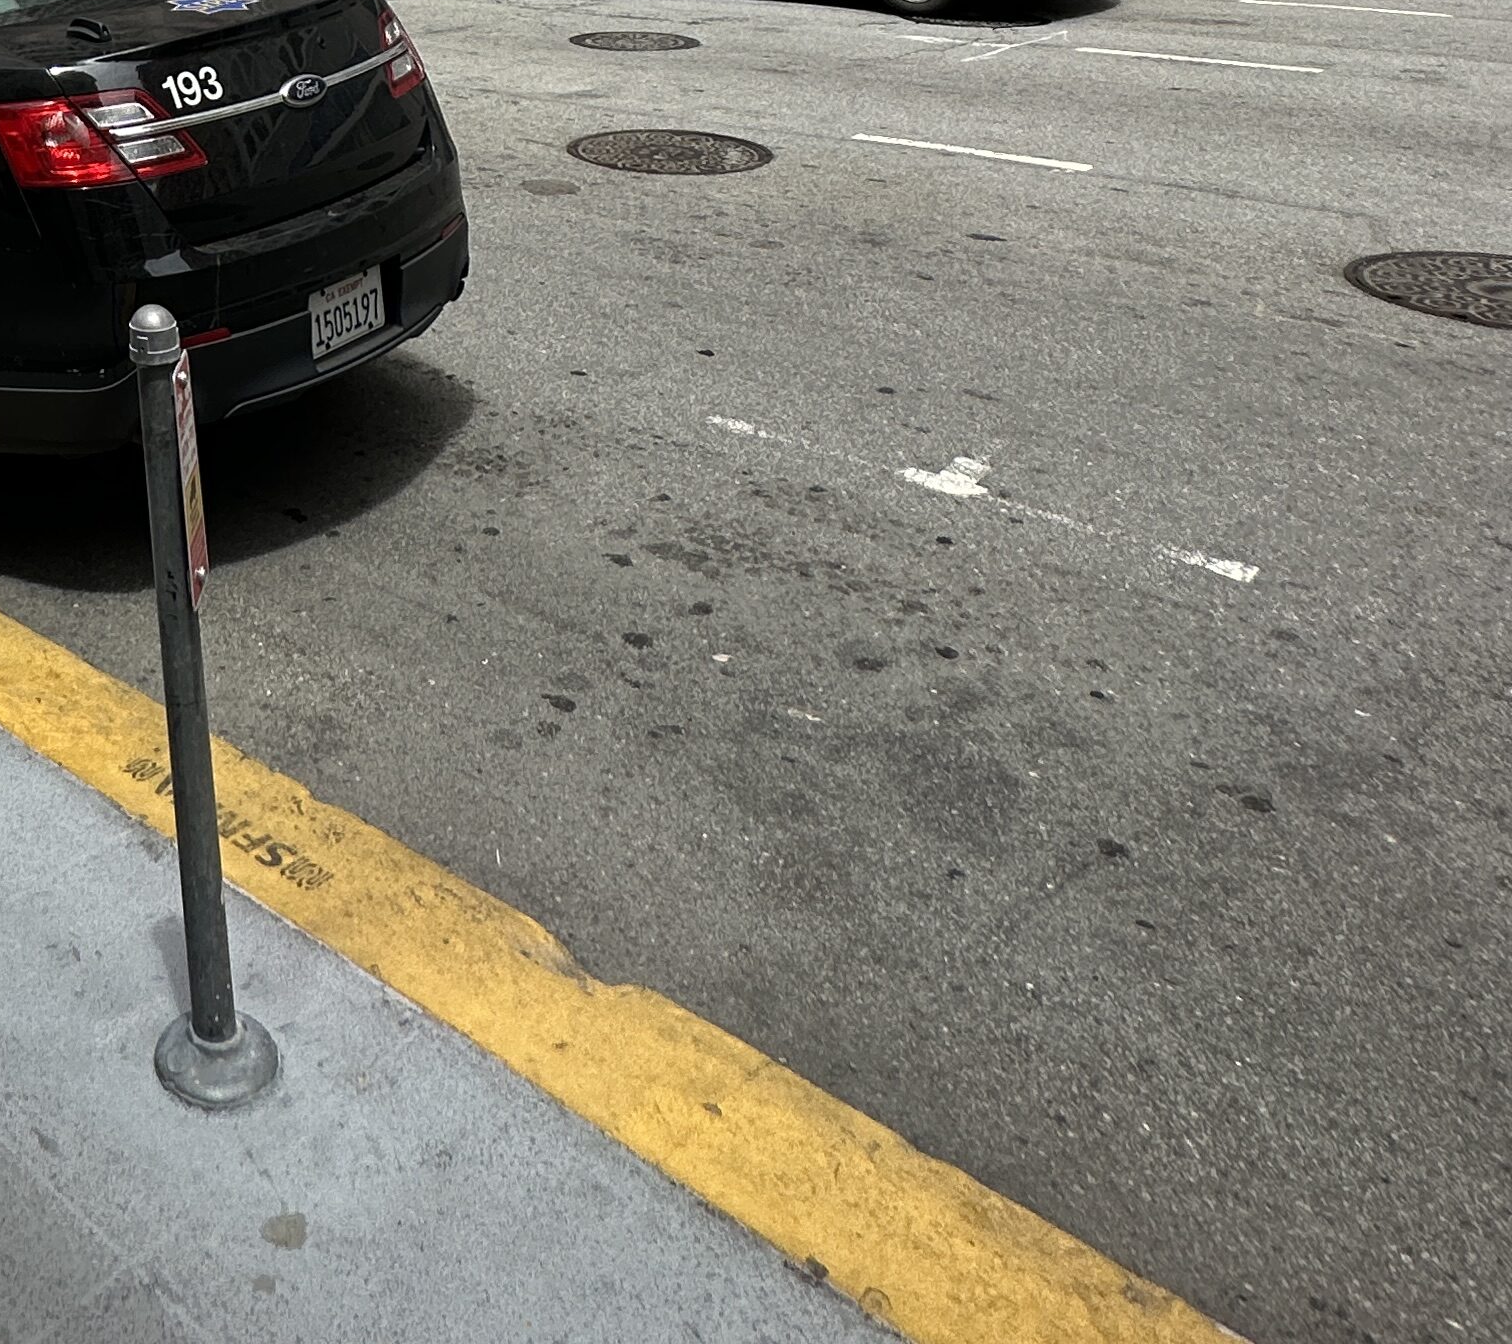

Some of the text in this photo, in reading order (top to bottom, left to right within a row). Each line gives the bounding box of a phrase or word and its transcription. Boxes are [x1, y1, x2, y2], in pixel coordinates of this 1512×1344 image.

[162, 66, 224, 109] 193
[296, 79, 321, 99] Ford
[315, 287, 379, 348] 1505197
